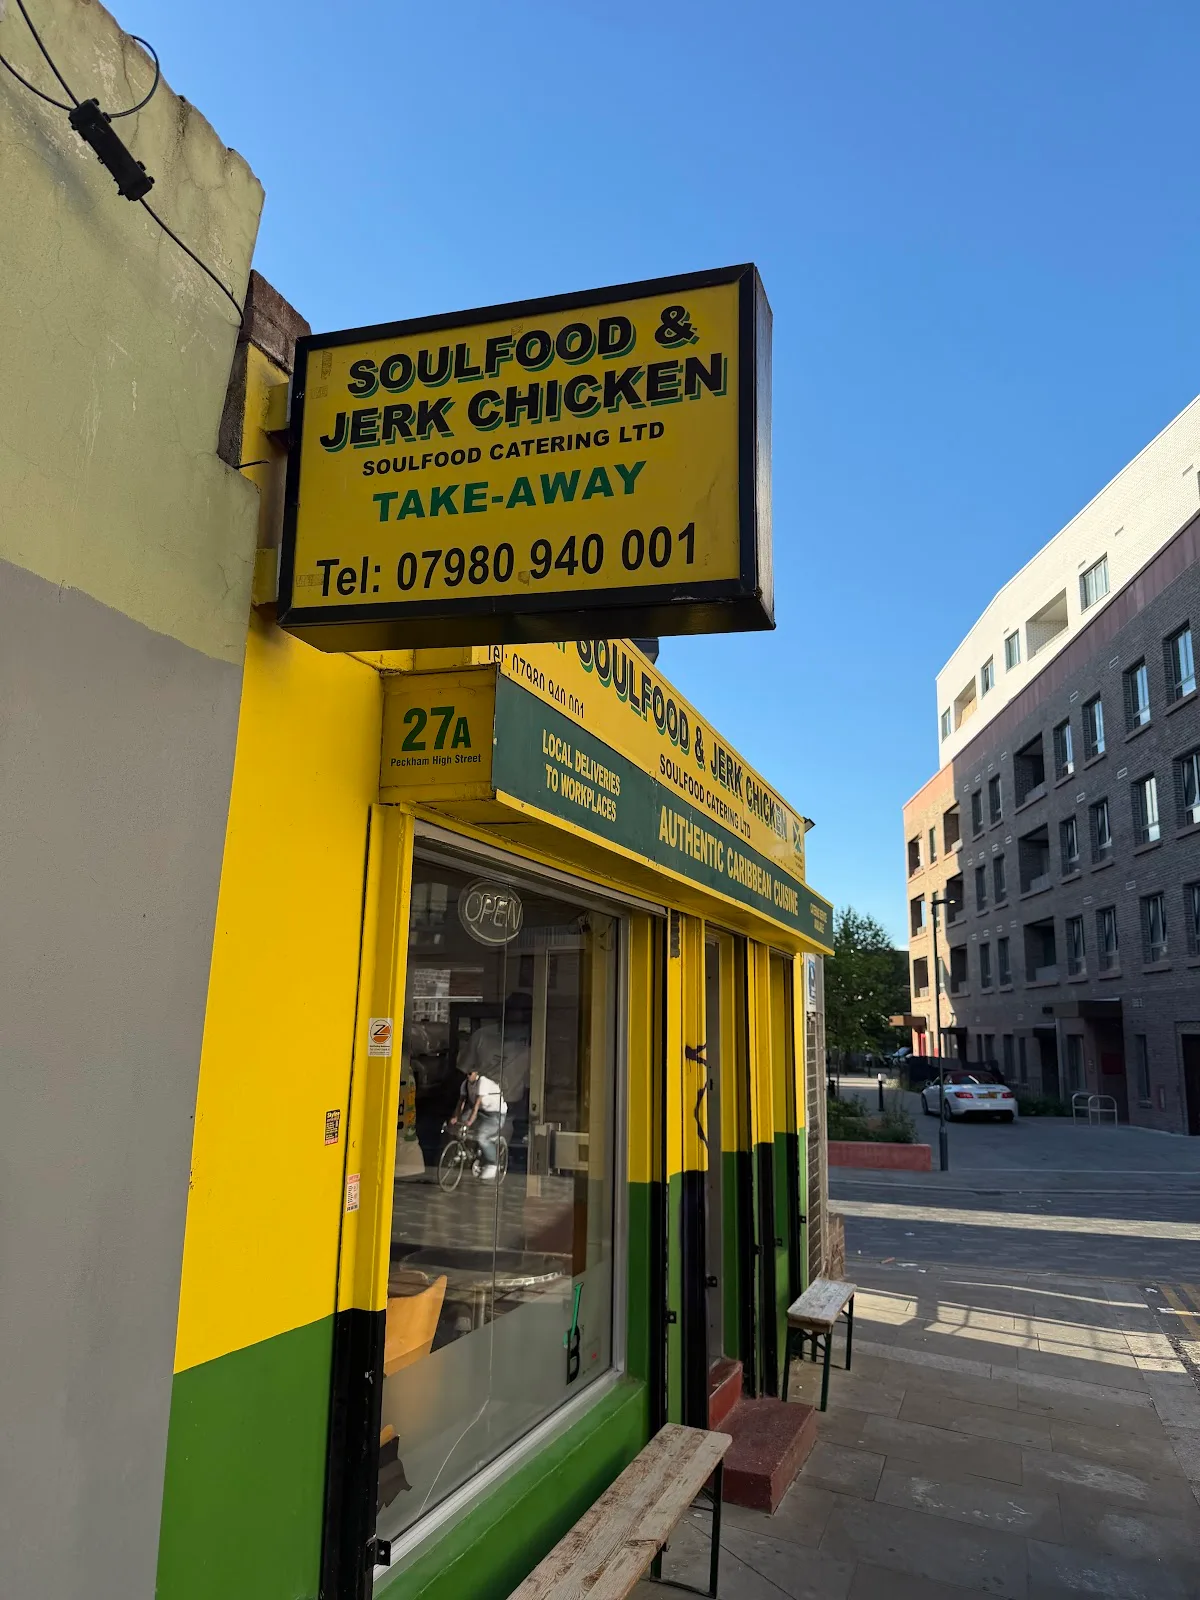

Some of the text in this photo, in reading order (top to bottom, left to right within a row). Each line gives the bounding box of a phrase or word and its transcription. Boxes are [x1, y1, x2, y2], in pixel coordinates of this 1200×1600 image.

[347, 305, 700, 398] SOULFOOD &
[319, 353, 727, 452] JERK CHICKEN
[362, 421, 665, 476] SOULFOOD CATERING LTD
[372, 461, 647, 522] TAKE-AWAY
[316, 522, 695, 596] Tel: 07980 940 001
[390, 753, 482, 767] Peckham High Street
[401, 706, 472, 751] 27A
[542, 728, 621, 797] LOCAL DELIVERIES
[576, 639, 788, 843] SOULFOOD & JERK CHICKEN
[545, 763, 617, 822] TO WORKPLACES
[659, 753, 751, 839] SOULFOOD CATERING LTD
[658, 805, 724, 873] AUTHENTIC
[726, 846, 772, 901] CARIBBEAN
[773, 879, 799, 917] CUISINE
[465, 891, 523, 931] OPEN
